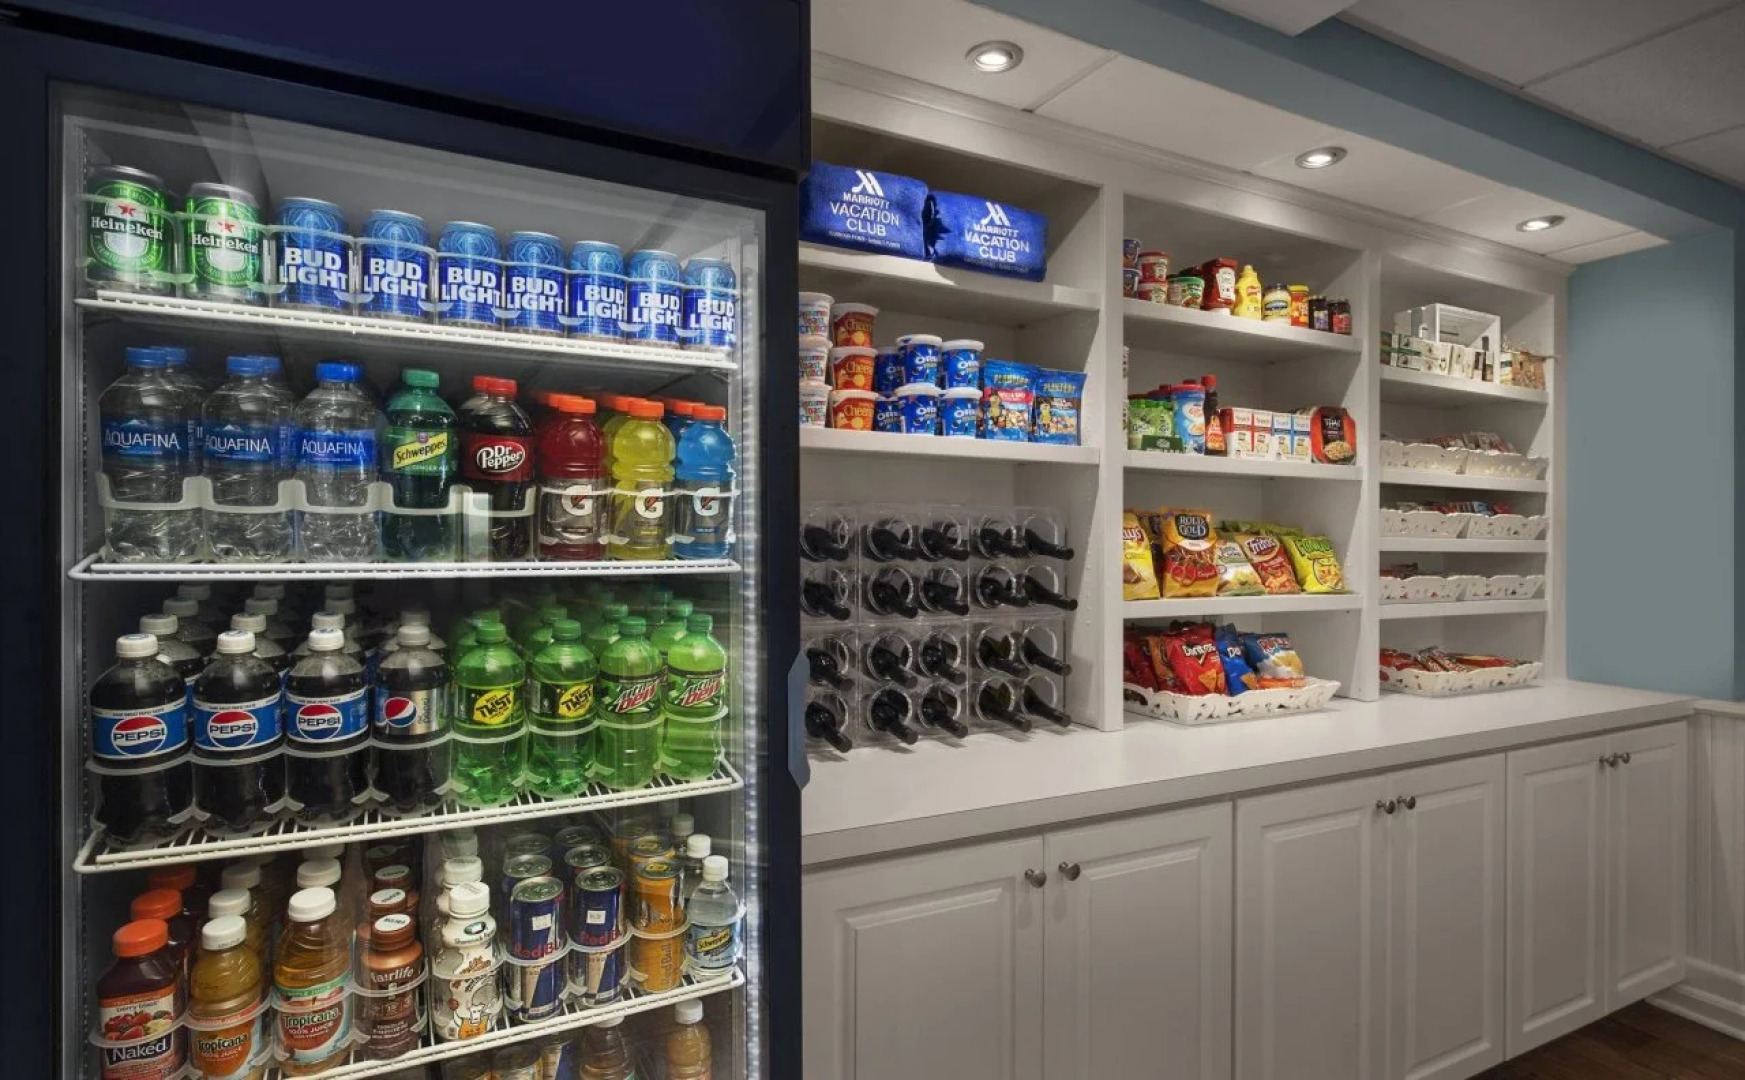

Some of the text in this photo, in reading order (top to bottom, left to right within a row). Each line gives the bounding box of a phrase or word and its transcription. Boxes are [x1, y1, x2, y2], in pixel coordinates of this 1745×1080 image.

[830, 201, 899, 226] VACATION
[91, 217, 163, 240] Heineken
[847, 218, 886, 236] CLUB
[193, 234, 259, 253] Heineken
[965, 229, 1030, 252] VACATION
[285, 247, 342, 270] BUD
[979, 246, 1016, 262] CLUB
[279, 266, 348, 290] LIGHT
[370, 258, 422, 280] BUD
[448, 267, 496, 288] BUD
[363, 275, 428, 299] LIGHT
[442, 284, 501, 306] LIGHT
[512, 277, 558, 296] BUD
[584, 284, 624, 304] BUD
[506, 293, 563, 314] LIGHT
[640, 292, 679, 310] BUD
[698, 298, 735, 317] BUD
[105, 428, 181, 450] AQUAFINA
[205, 434, 273, 454] AQUAFINA
[301, 438, 366, 457] AQUAFINA
[396, 441, 446, 464] Schweppes
[482, 448, 521, 470] Pepper
[494, 446, 512, 459] Dr
[561, 484, 593, 516] G
[635, 487, 664, 519] G
[693, 487, 720, 516] G
[210, 722, 256, 735] PEPSI
[298, 716, 341, 727] PEPSI
[113, 727, 166, 742] PEPSI
[283, 1008, 339, 1028] Tropicana
[112, 1038, 166, 1062] Naked
[197, 1033, 248, 1052] Tropicana
